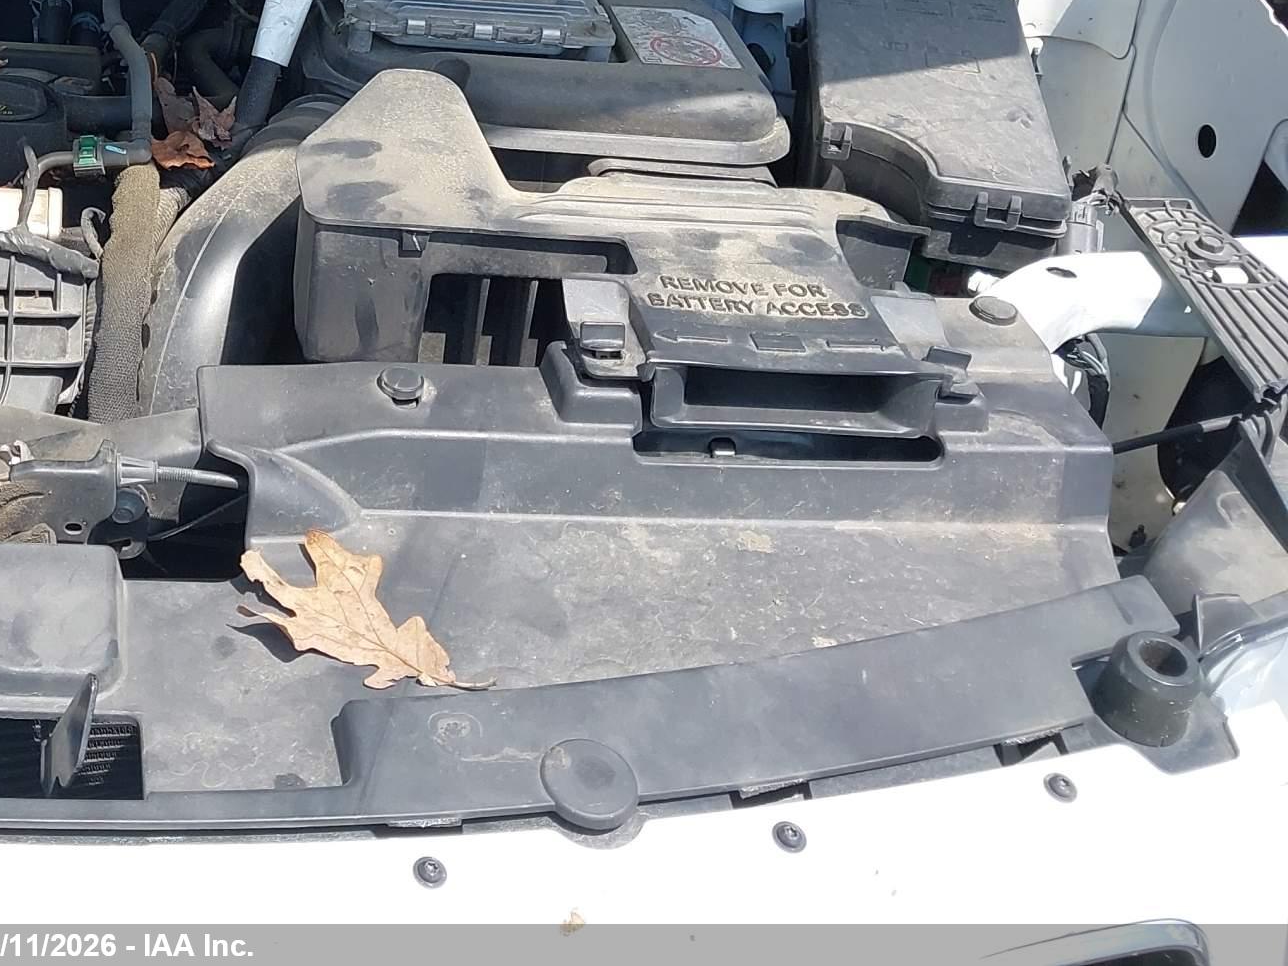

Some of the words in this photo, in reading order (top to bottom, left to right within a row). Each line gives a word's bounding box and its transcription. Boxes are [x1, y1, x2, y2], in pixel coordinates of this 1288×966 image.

[659, 275, 768, 297] REMOVE
[773, 283, 828, 299] FOR
[646, 292, 755, 315] BATTERY
[766, 301, 866, 318] ACCESS
